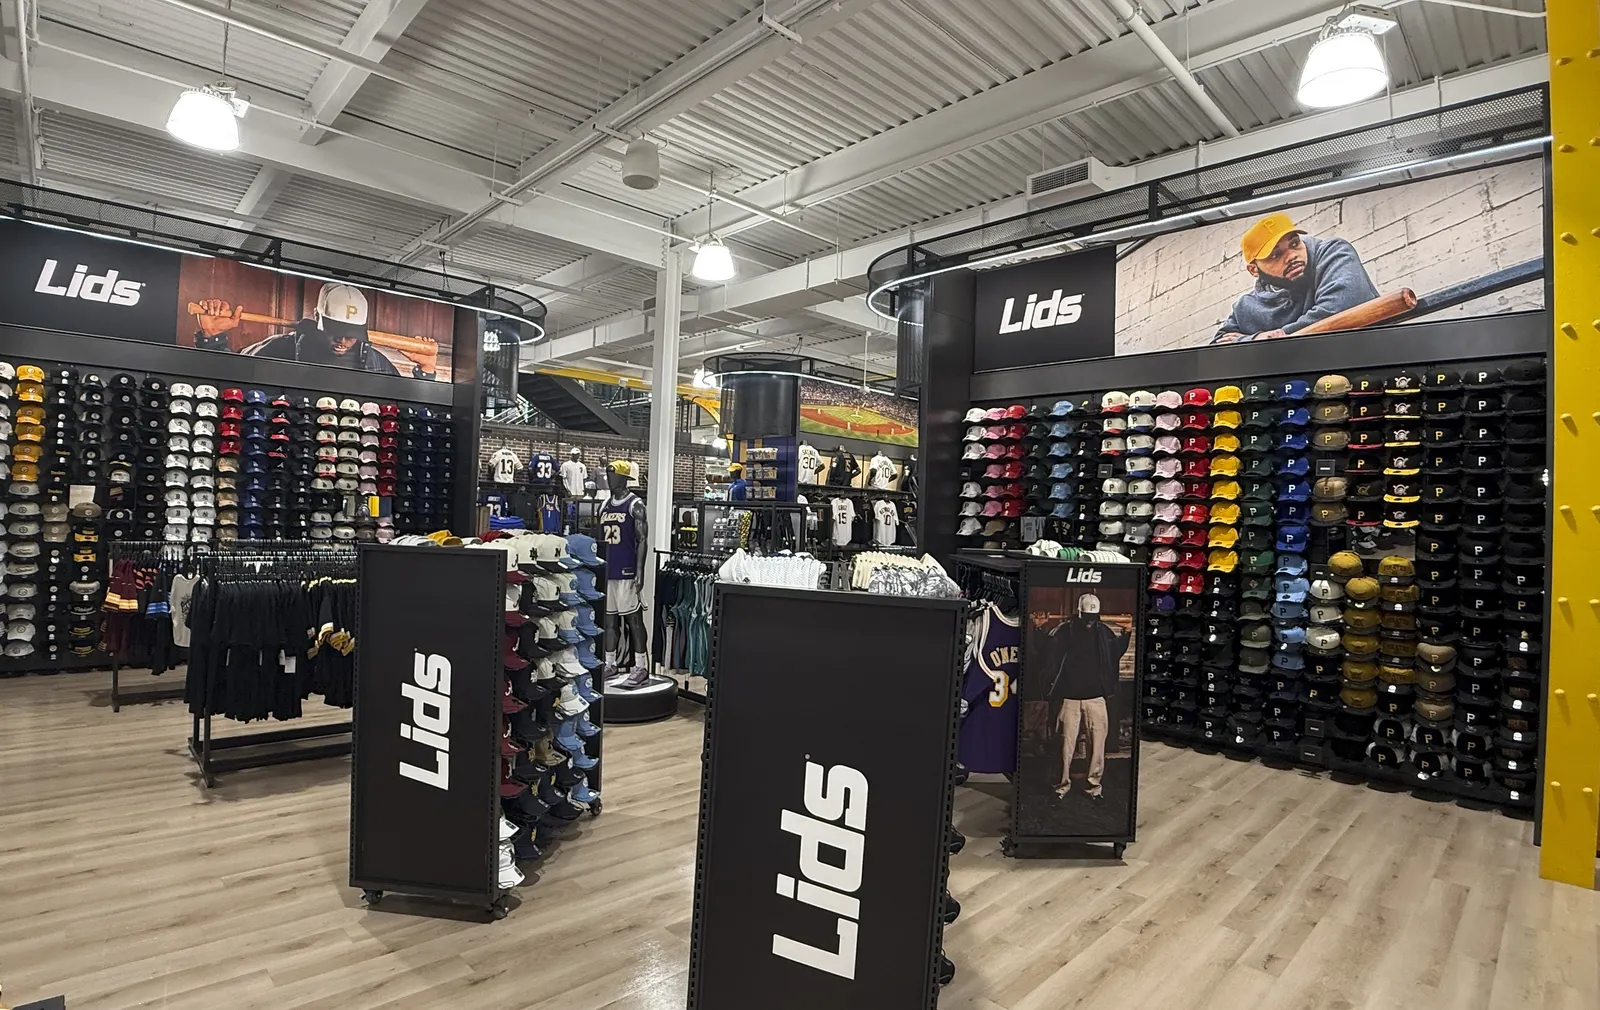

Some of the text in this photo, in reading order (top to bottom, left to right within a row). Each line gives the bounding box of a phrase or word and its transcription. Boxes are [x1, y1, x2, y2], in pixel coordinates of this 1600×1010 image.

[1263, 219, 1276, 233] P
[35, 259, 142, 306] Lids
[346, 305, 357, 319] P
[999, 289, 1082, 334] Lids
[1438, 375, 1445, 384] P
[1479, 372, 1487, 382] P
[1361, 382, 1368, 390] P
[1438, 402, 1446, 411] P
[1479, 401, 1486, 410] P
[1436, 431, 1443, 439] P
[1479, 429, 1487, 437] P
[803, 457, 815, 469] 30
[1358, 460, 1364, 468] P
[1478, 457, 1486, 466] P
[499, 459, 513, 474] 13
[537, 462, 551, 478] 33
[882, 467, 889, 478] 10
[1436, 488, 1443, 496] P
[1478, 488, 1485, 496] P
[838, 513, 846, 524] 15
[1435, 514, 1443, 523] P
[1478, 515, 1485, 524] P
[604, 525, 620, 544] 23
[1431, 543, 1438, 552] P
[1475, 546, 1483, 555] P
[1066, 568, 1102, 582] Lids
[1474, 570, 1482, 579] P
[1518, 576, 1526, 584] P
[1476, 600, 1483, 608] P
[1518, 602, 1526, 610] P
[1473, 628, 1480, 636] P
[990, 647, 1019, 667] O'NE
[1474, 658, 1482, 666] P
[989, 670, 1018, 707] 3
[1472, 684, 1480, 692] P
[400, 652, 451, 790] Lids
[1467, 713, 1475, 722] P
[1425, 734, 1432, 743] P
[1468, 742, 1475, 750] P
[1422, 761, 1429, 769] P
[772, 761, 868, 980] Lids
